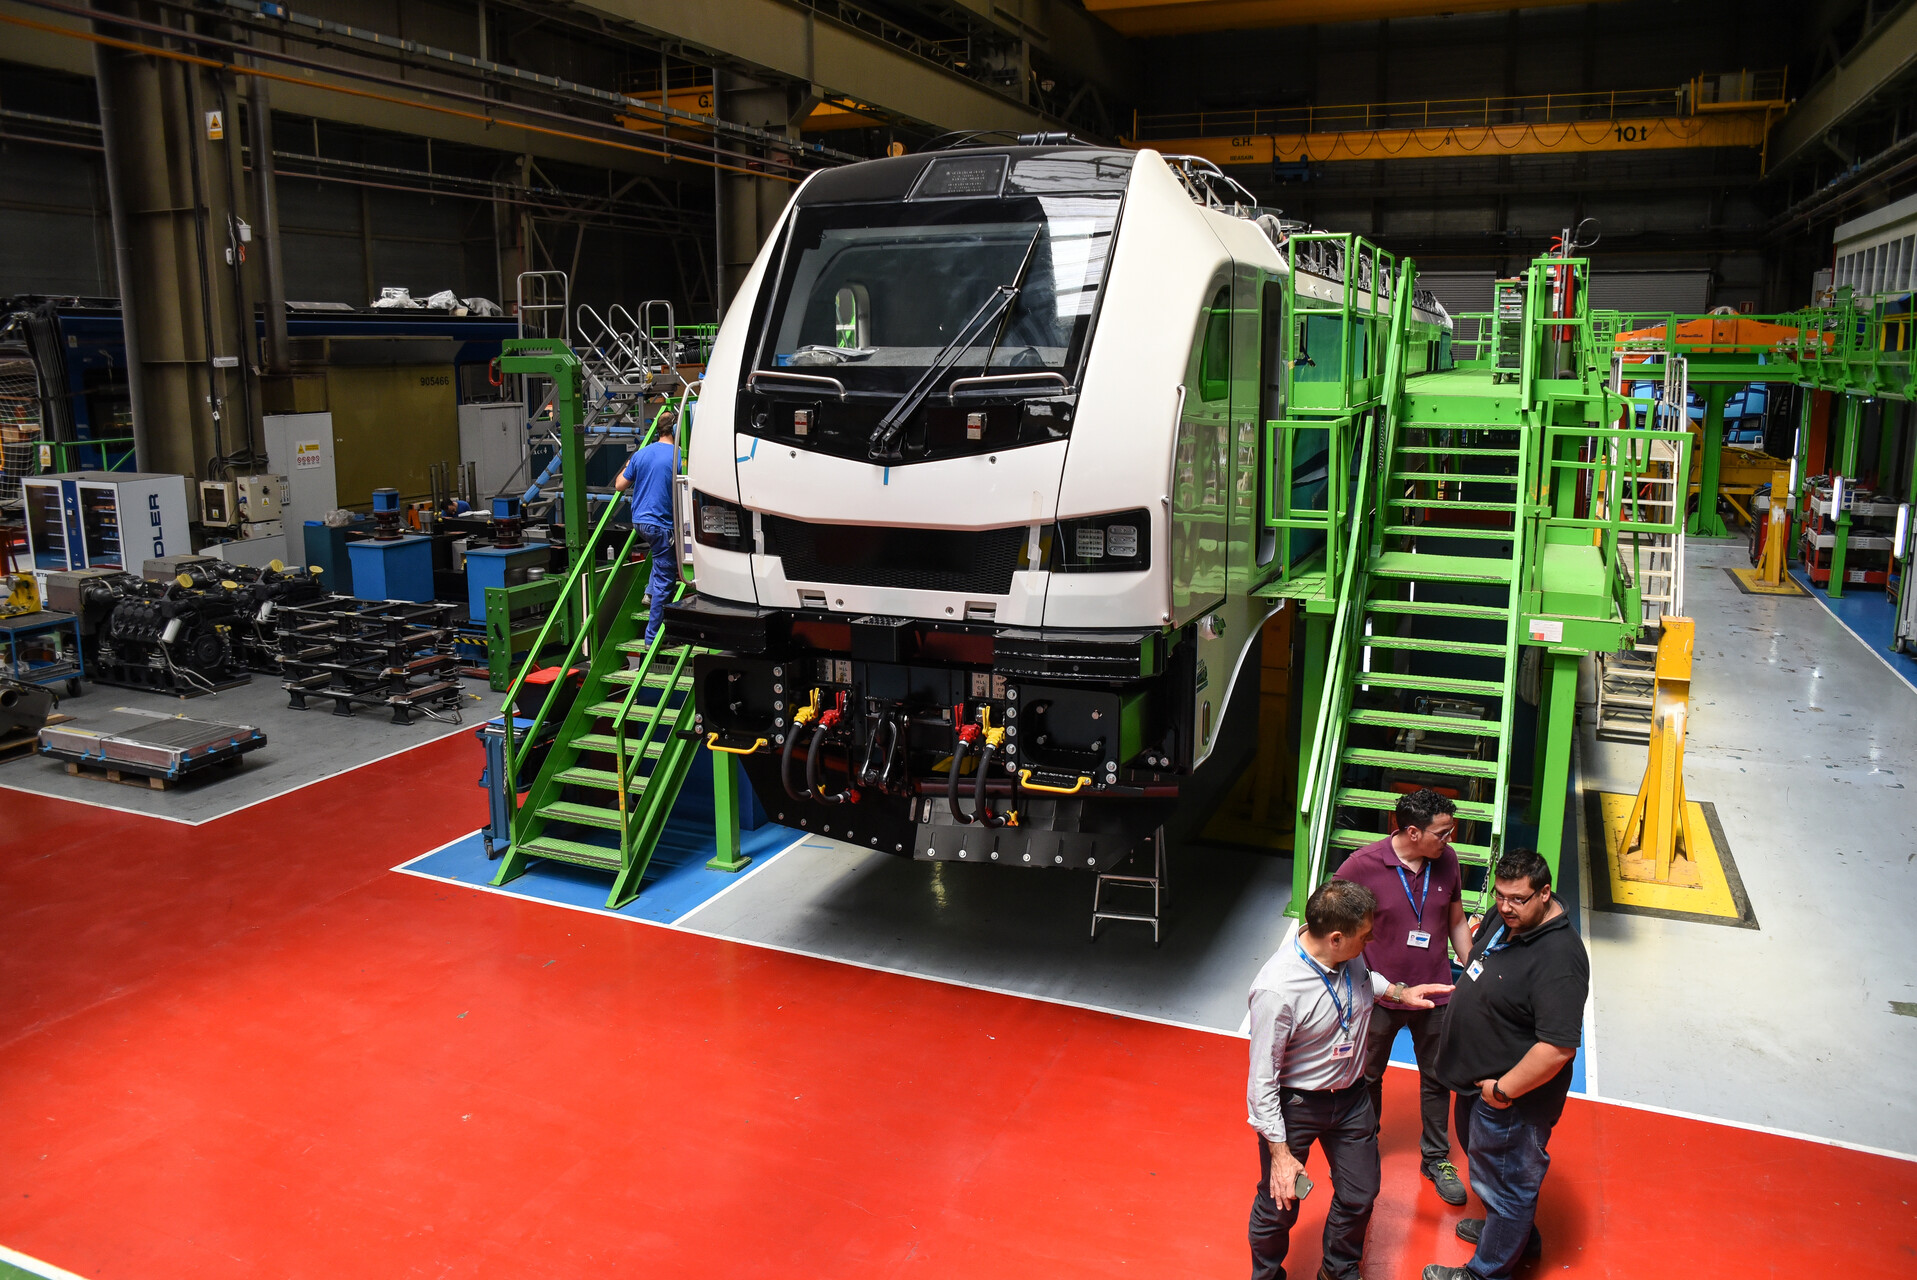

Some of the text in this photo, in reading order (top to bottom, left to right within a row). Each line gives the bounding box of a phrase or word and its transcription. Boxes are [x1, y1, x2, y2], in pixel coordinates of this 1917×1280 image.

[698, 94, 712, 108] G.
[1614, 126, 1648, 142] 10 t
[1232, 137, 1253, 147] G.H.
[420, 376, 449, 387] 905466
[149, 494, 165, 558] DLER
